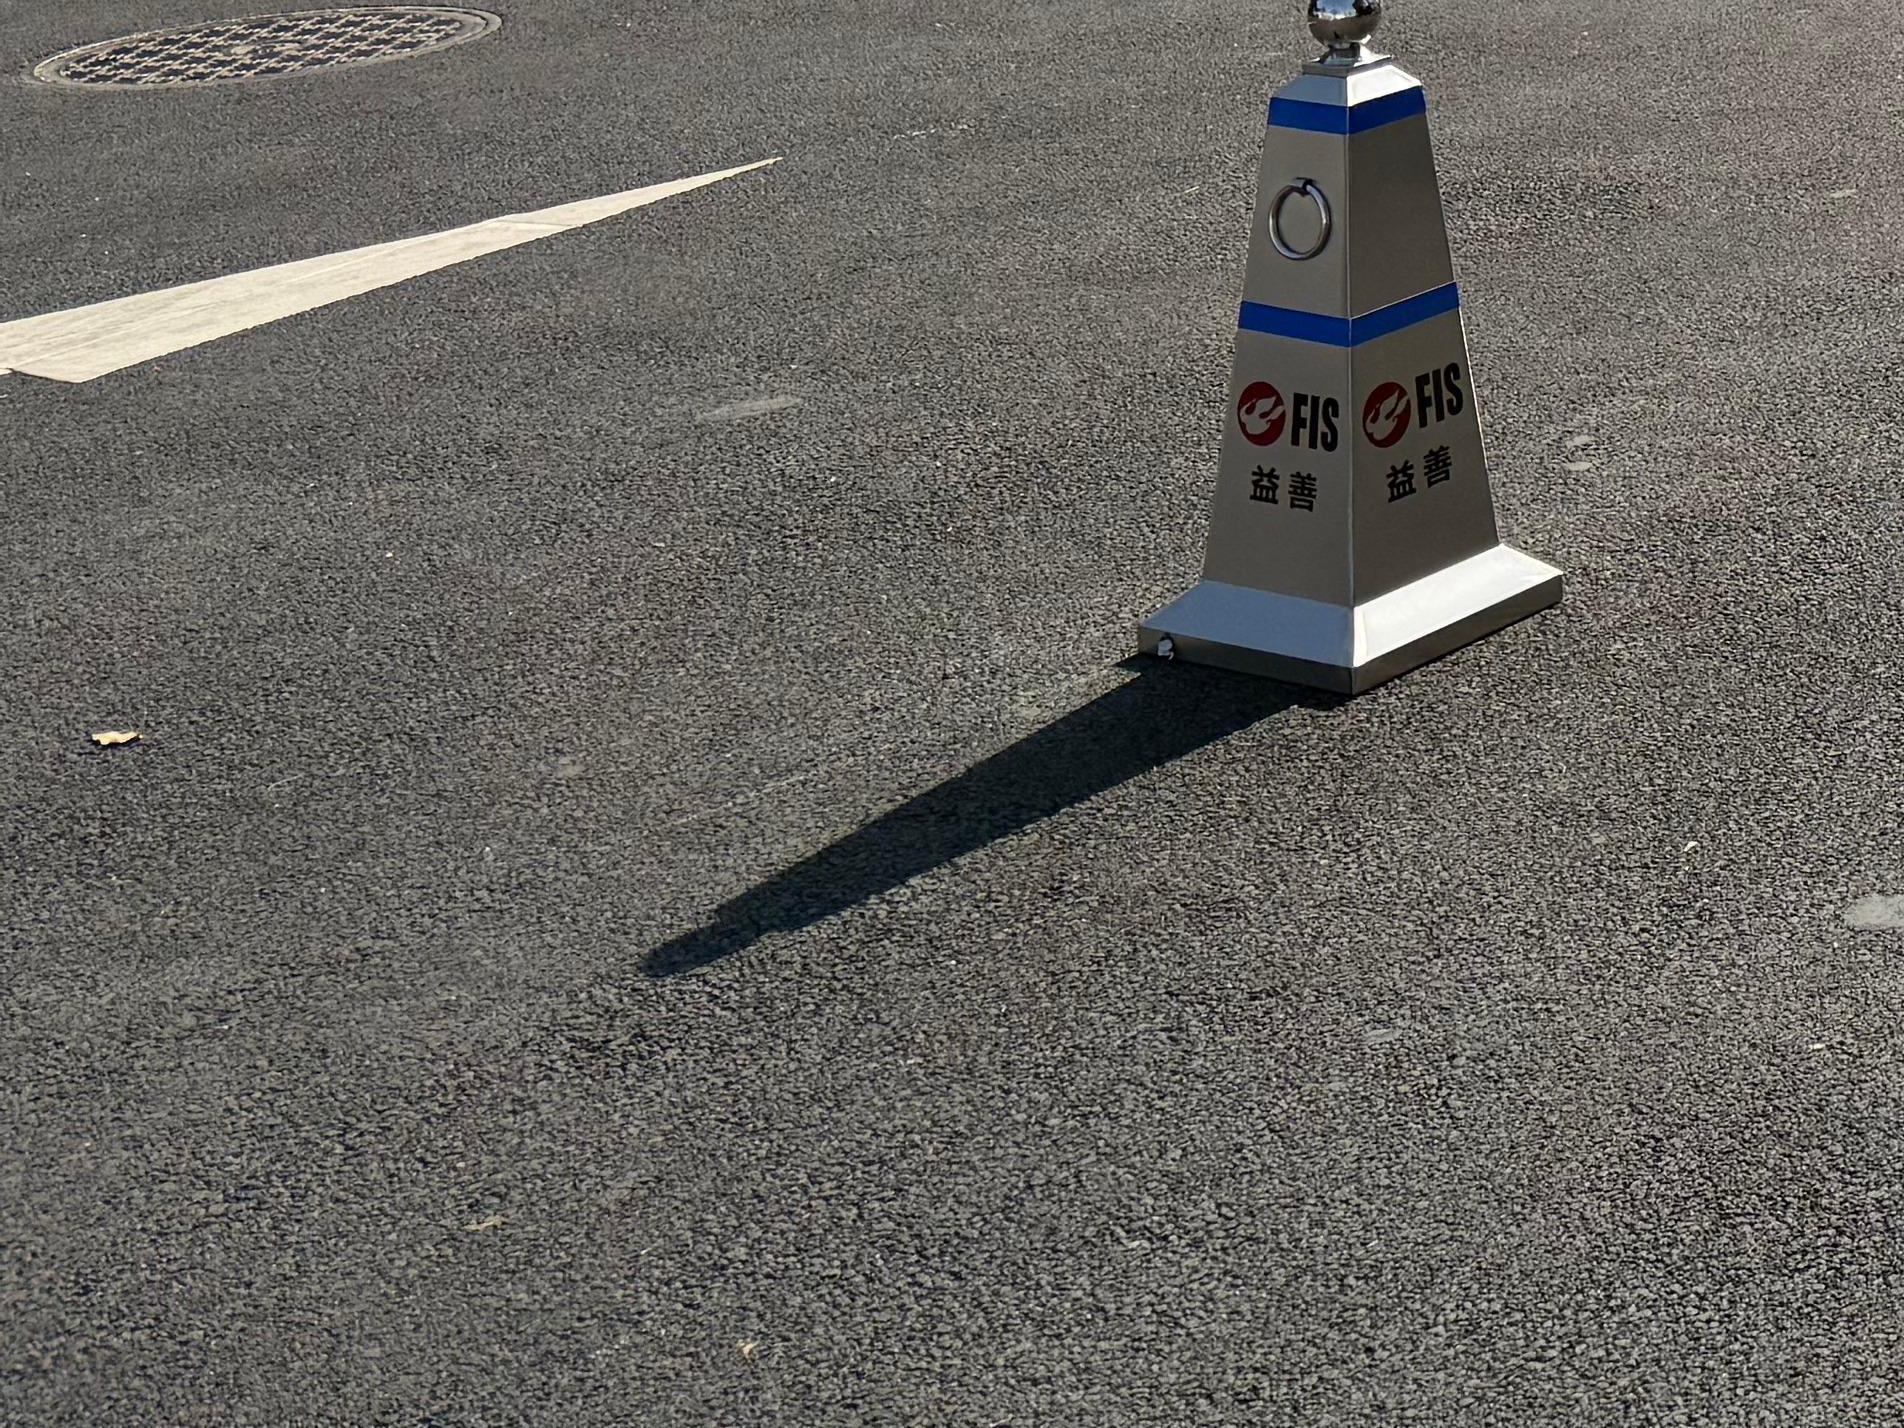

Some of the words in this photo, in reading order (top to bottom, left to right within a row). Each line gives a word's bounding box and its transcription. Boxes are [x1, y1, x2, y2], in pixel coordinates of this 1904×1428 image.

[1291, 392, 1340, 453] FIS
[1414, 362, 1464, 429] FIS
[1250, 464, 1317, 513] 益善
[1385, 445, 1453, 504] 益善
